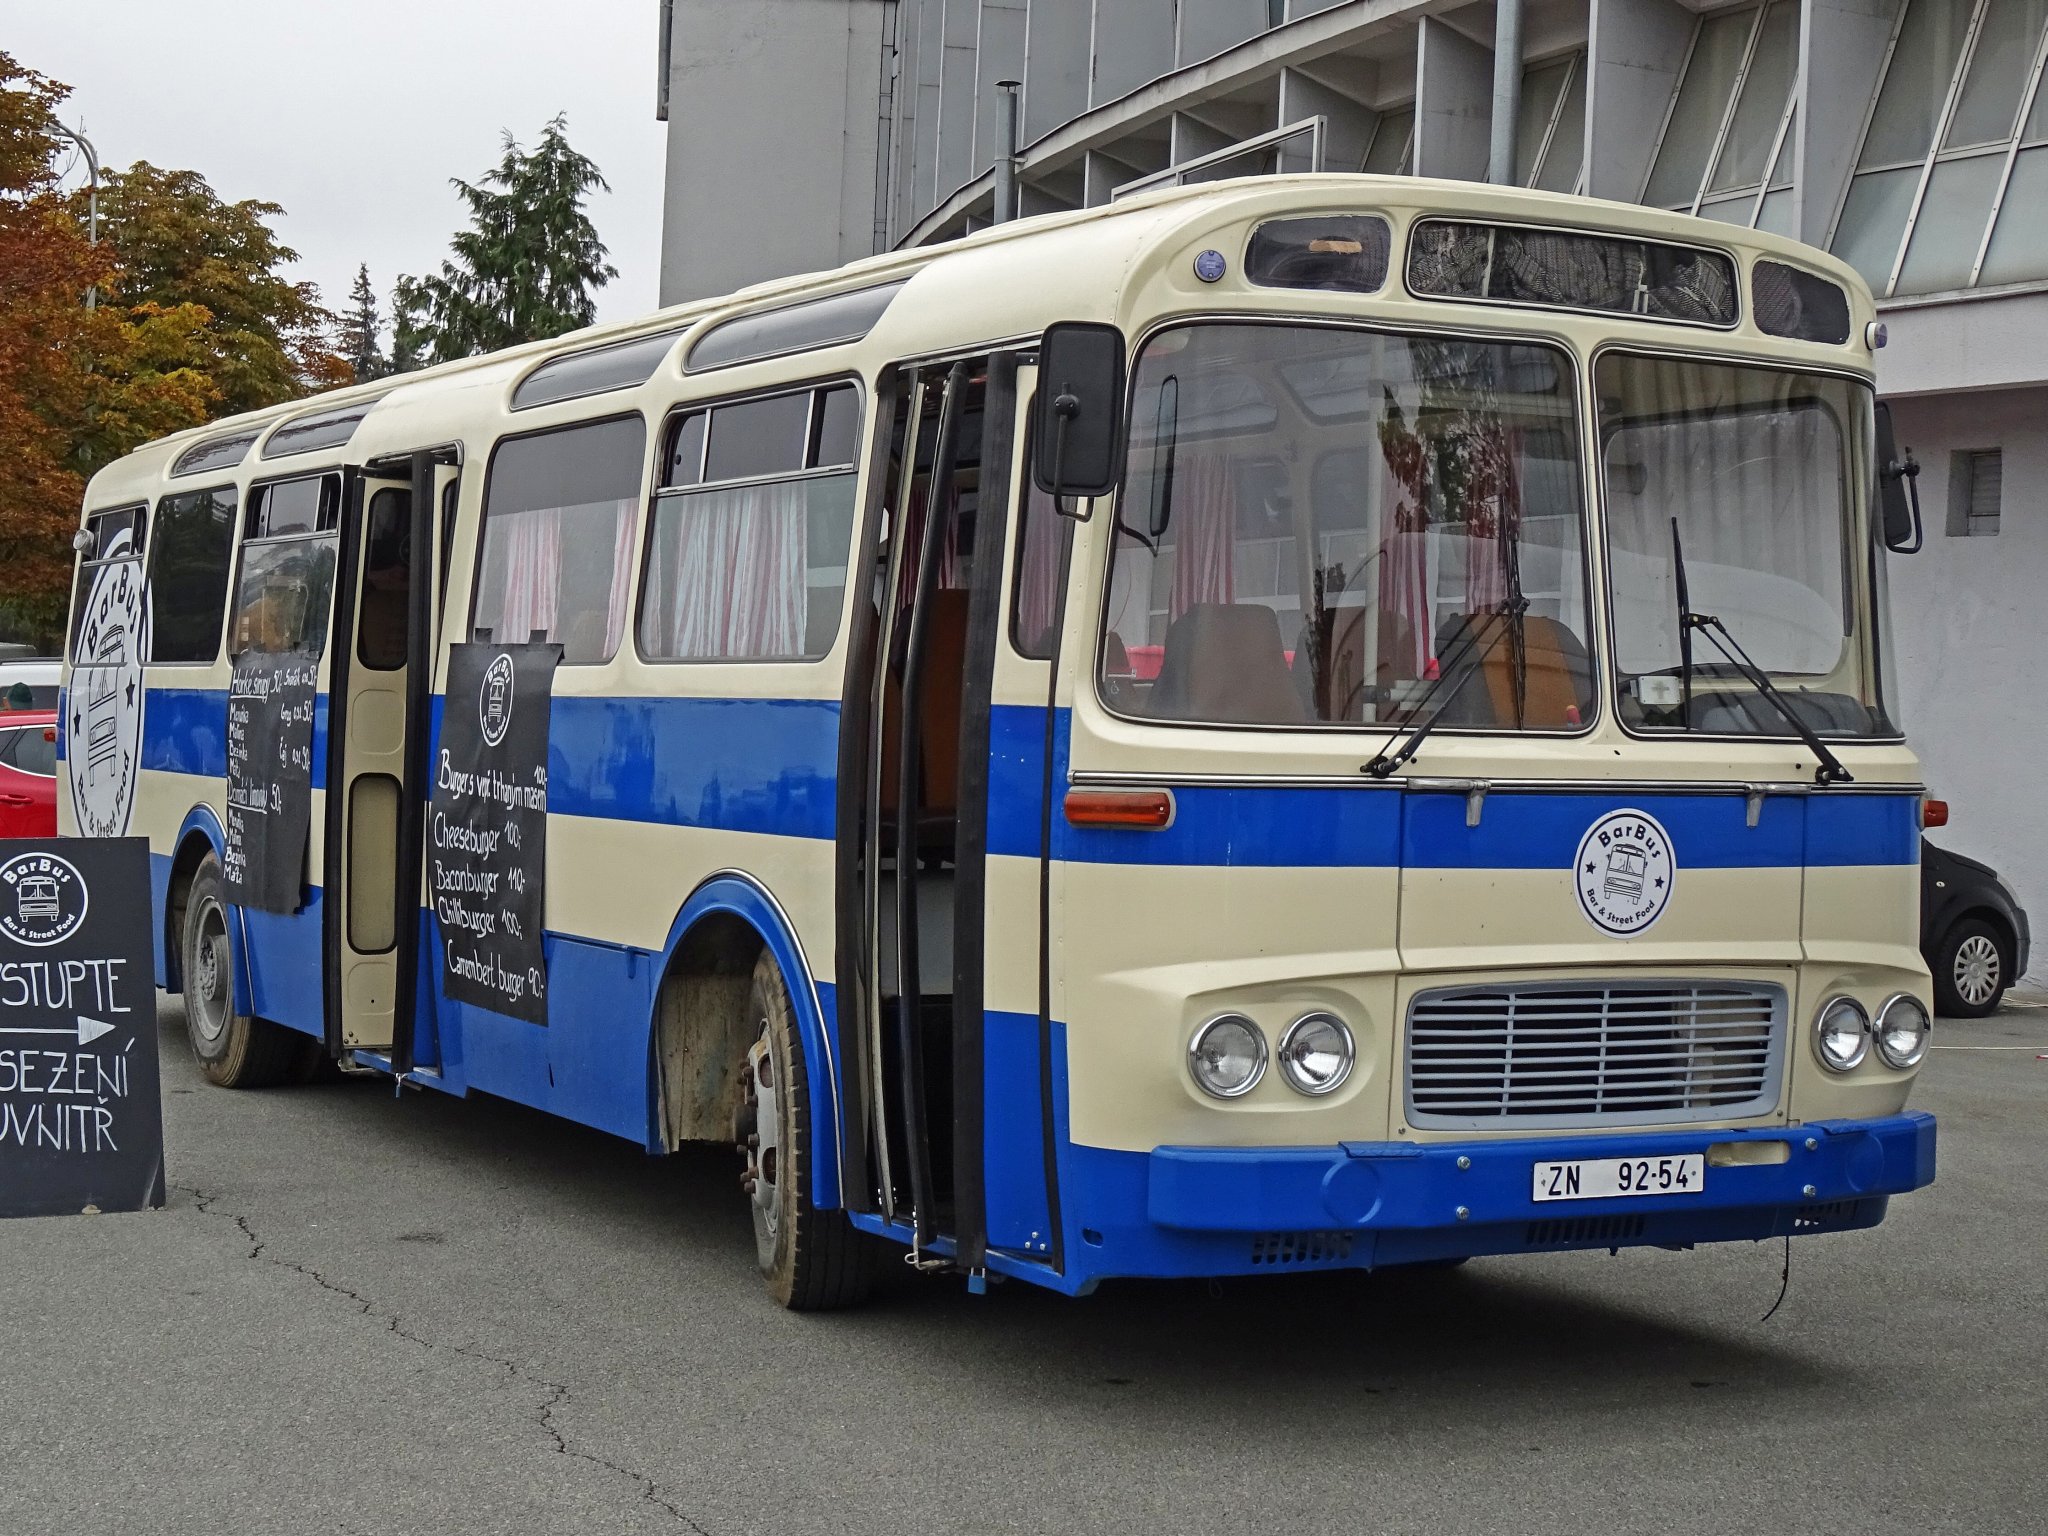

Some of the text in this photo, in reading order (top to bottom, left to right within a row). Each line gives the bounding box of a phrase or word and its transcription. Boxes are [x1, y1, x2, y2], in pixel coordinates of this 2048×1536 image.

[87, 564, 138, 661] BarBus
[78, 771, 88, 817] Bar
[97, 810, 117, 838] Street
[115, 748, 130, 816] Food
[438, 748, 469, 800] Burger
[434, 811, 500, 861] Cheeseburger
[1598, 824, 1661, 859] BarBus
[3, 858, 71, 884] BarBus
[435, 860, 500, 901] Baconburger
[3, 913, 76, 939] Bar & Street Food
[1587, 888, 1656, 925] Bar & Street Food
[0, 958, 131, 1013] STUPTE
[447, 938, 496, 989] Camembert
[498, 953, 525, 1003] burger
[1548, 1165, 1581, 1197] ZN
